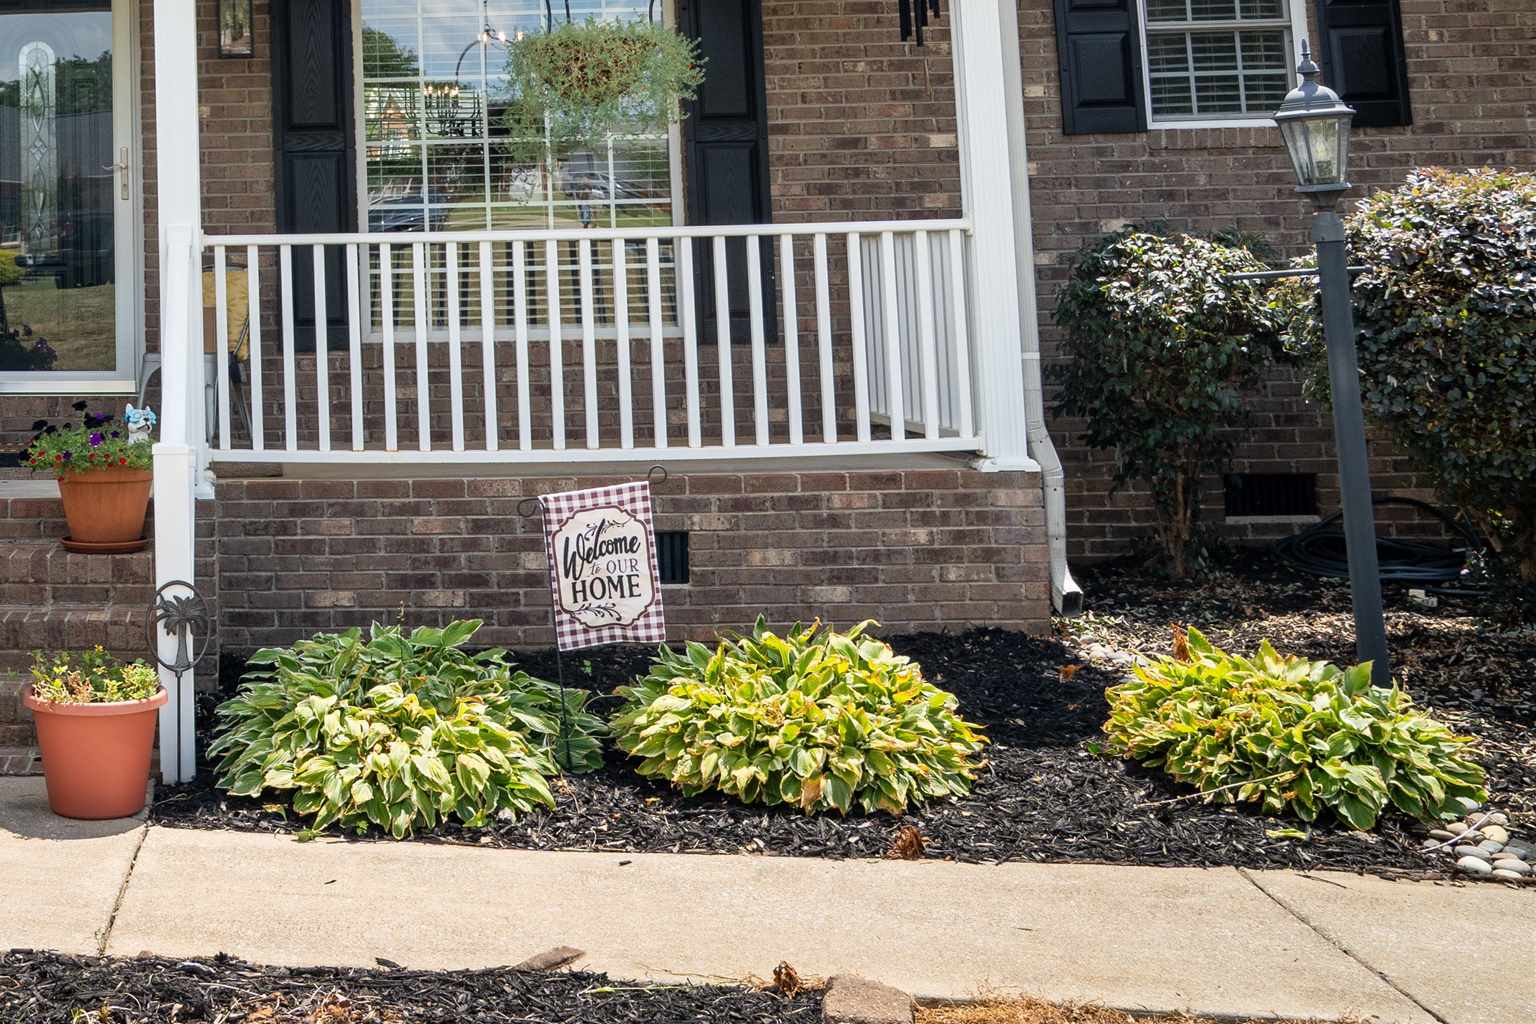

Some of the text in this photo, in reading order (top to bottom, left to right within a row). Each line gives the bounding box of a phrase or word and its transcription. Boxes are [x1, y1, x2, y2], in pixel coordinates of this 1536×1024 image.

[564, 518, 641, 580] Welcome
[590, 558, 639, 577] to OUR
[571, 574, 642, 603] HOME
